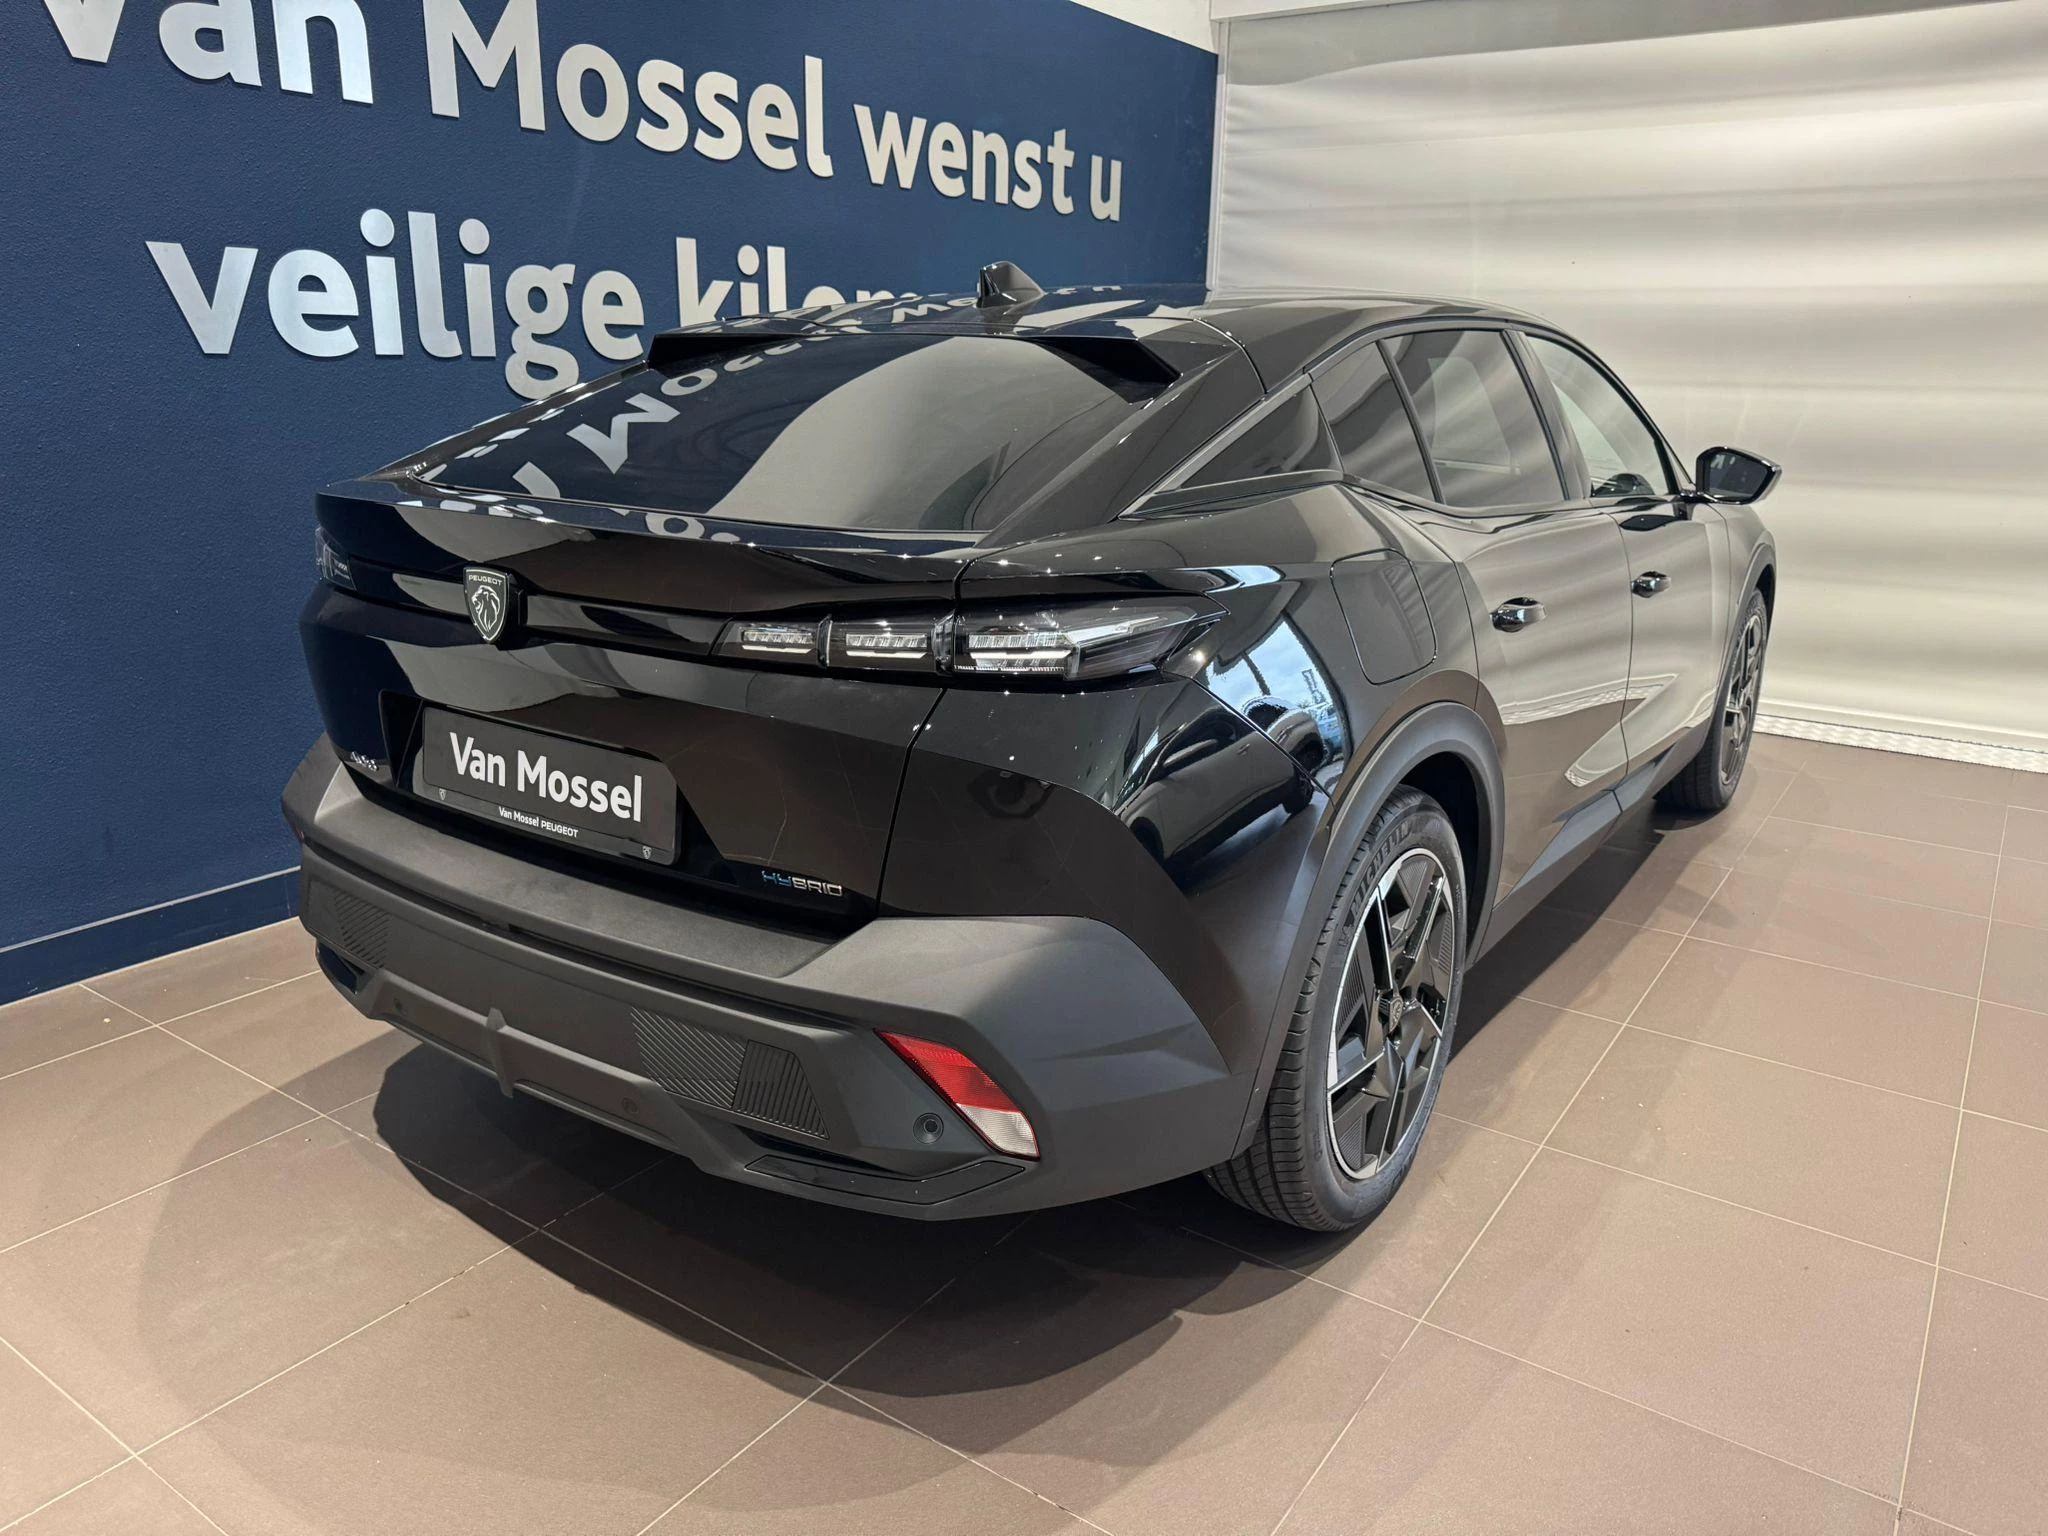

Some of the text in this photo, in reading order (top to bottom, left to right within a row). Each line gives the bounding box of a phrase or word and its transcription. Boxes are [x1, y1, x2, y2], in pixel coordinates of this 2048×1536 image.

[423, 0, 833, 178] Mossel
[853, 103, 1075, 214] wenst
[1089, 155, 1122, 222] u
[145, 208, 645, 400] veilige
[468, 574, 503, 586] PEUGEOT
[450, 731, 642, 823] Van Mossel
[498, 806, 579, 838] Van Mossel PEUGEOT
[761, 870, 843, 897] HYBRID
